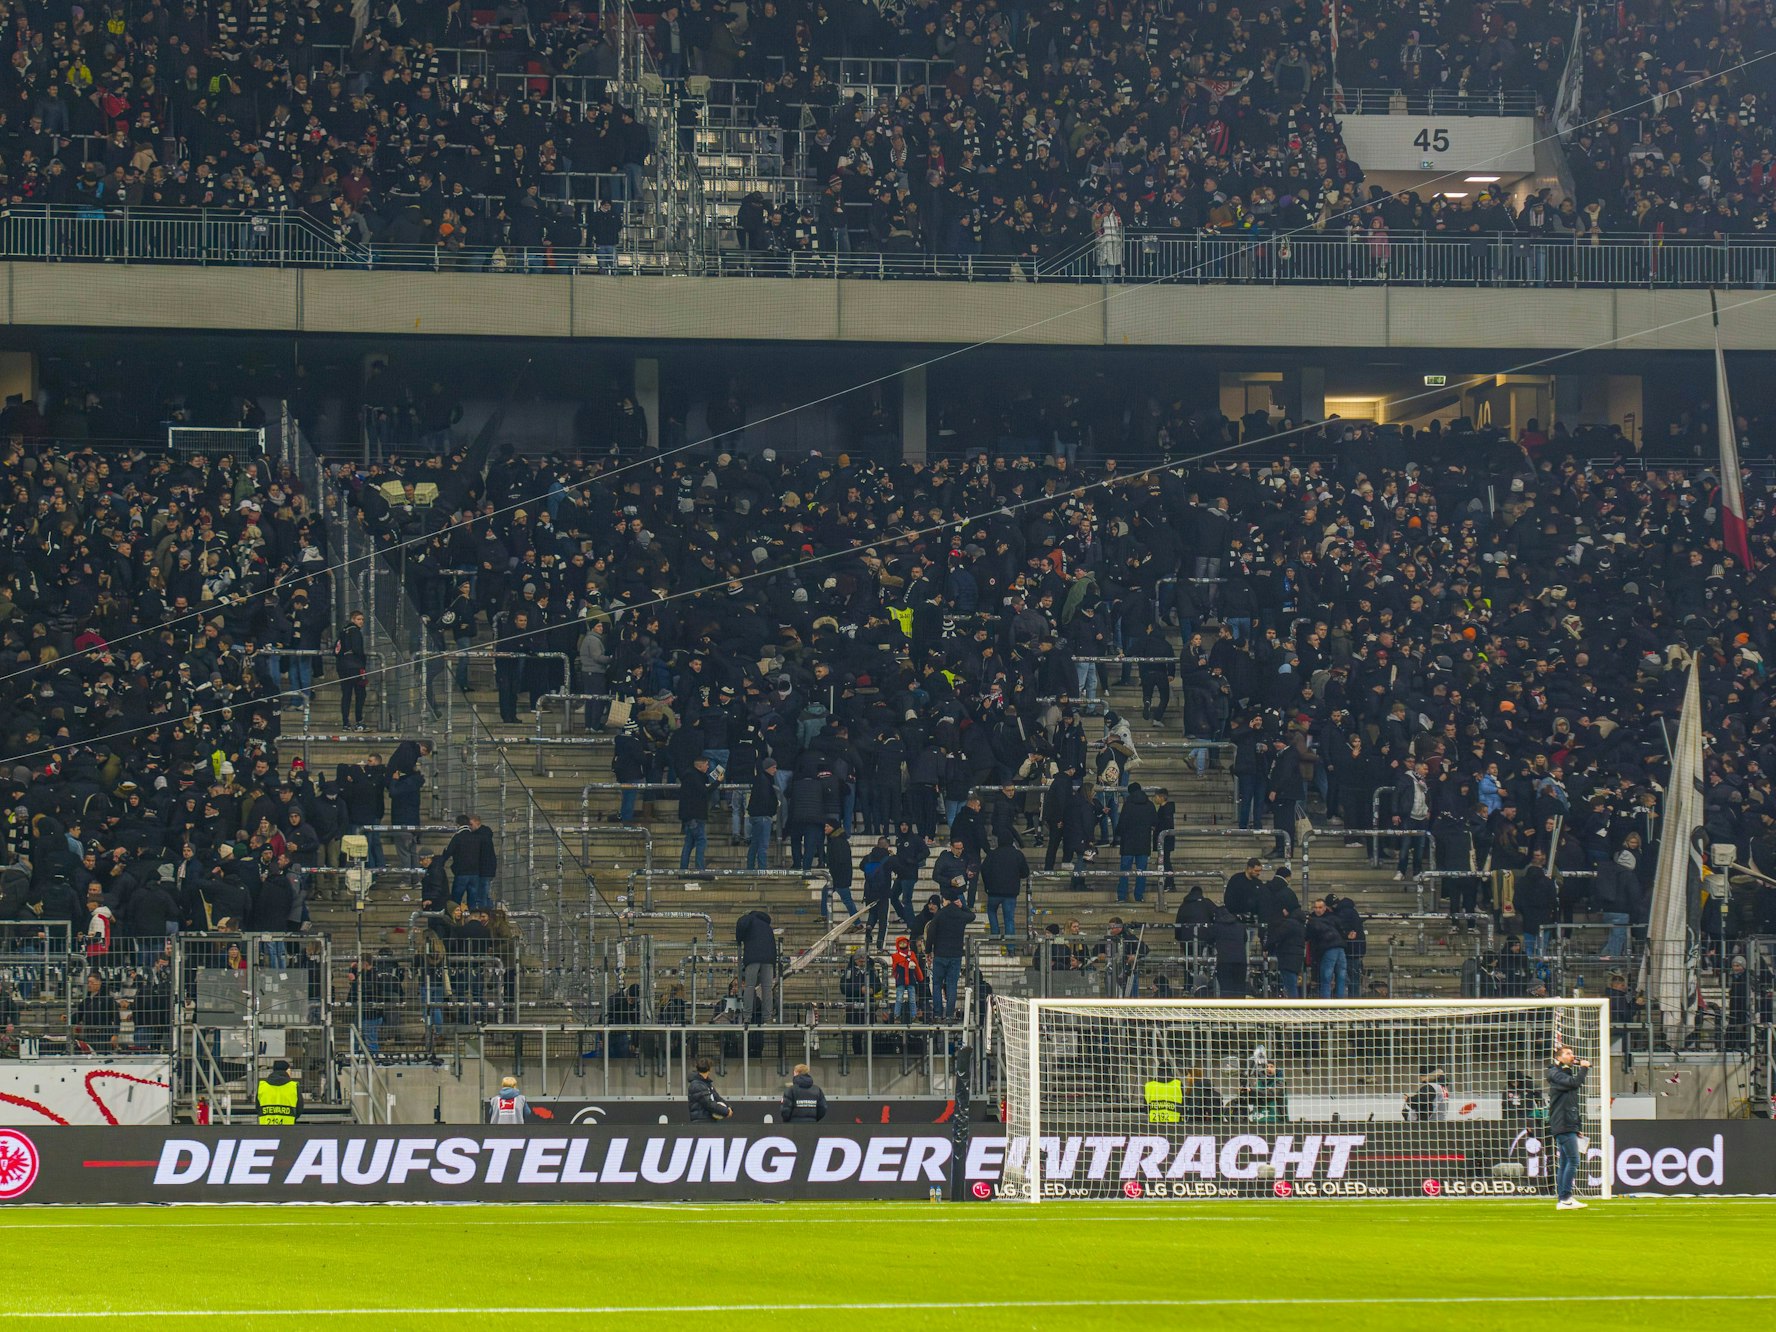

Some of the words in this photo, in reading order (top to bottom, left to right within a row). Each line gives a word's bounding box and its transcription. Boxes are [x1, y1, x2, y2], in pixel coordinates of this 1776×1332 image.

[1413, 128, 1450, 152] 45
[262, 1106, 291, 1115] STEWARD
[153, 1139, 281, 1185] DIE
[283, 1136, 798, 1184] AUFSTELLUNG
[807, 1136, 953, 1182] DER
[964, 1134, 1366, 1180] EINTRACHT
[993, 1183, 1017, 1197] LG
[1069, 1188, 1089, 1196] evo
[1145, 1183, 1168, 1196] LG
[1172, 1182, 1217, 1196] OLED
[1219, 1187, 1239, 1196] evo
[1294, 1182, 1317, 1195] LG
[1322, 1181, 1367, 1195] OLED
[1368, 1186, 1389, 1195] evo
[1444, 1181, 1467, 1194] LG
[1471, 1180, 1516, 1194] OLED
